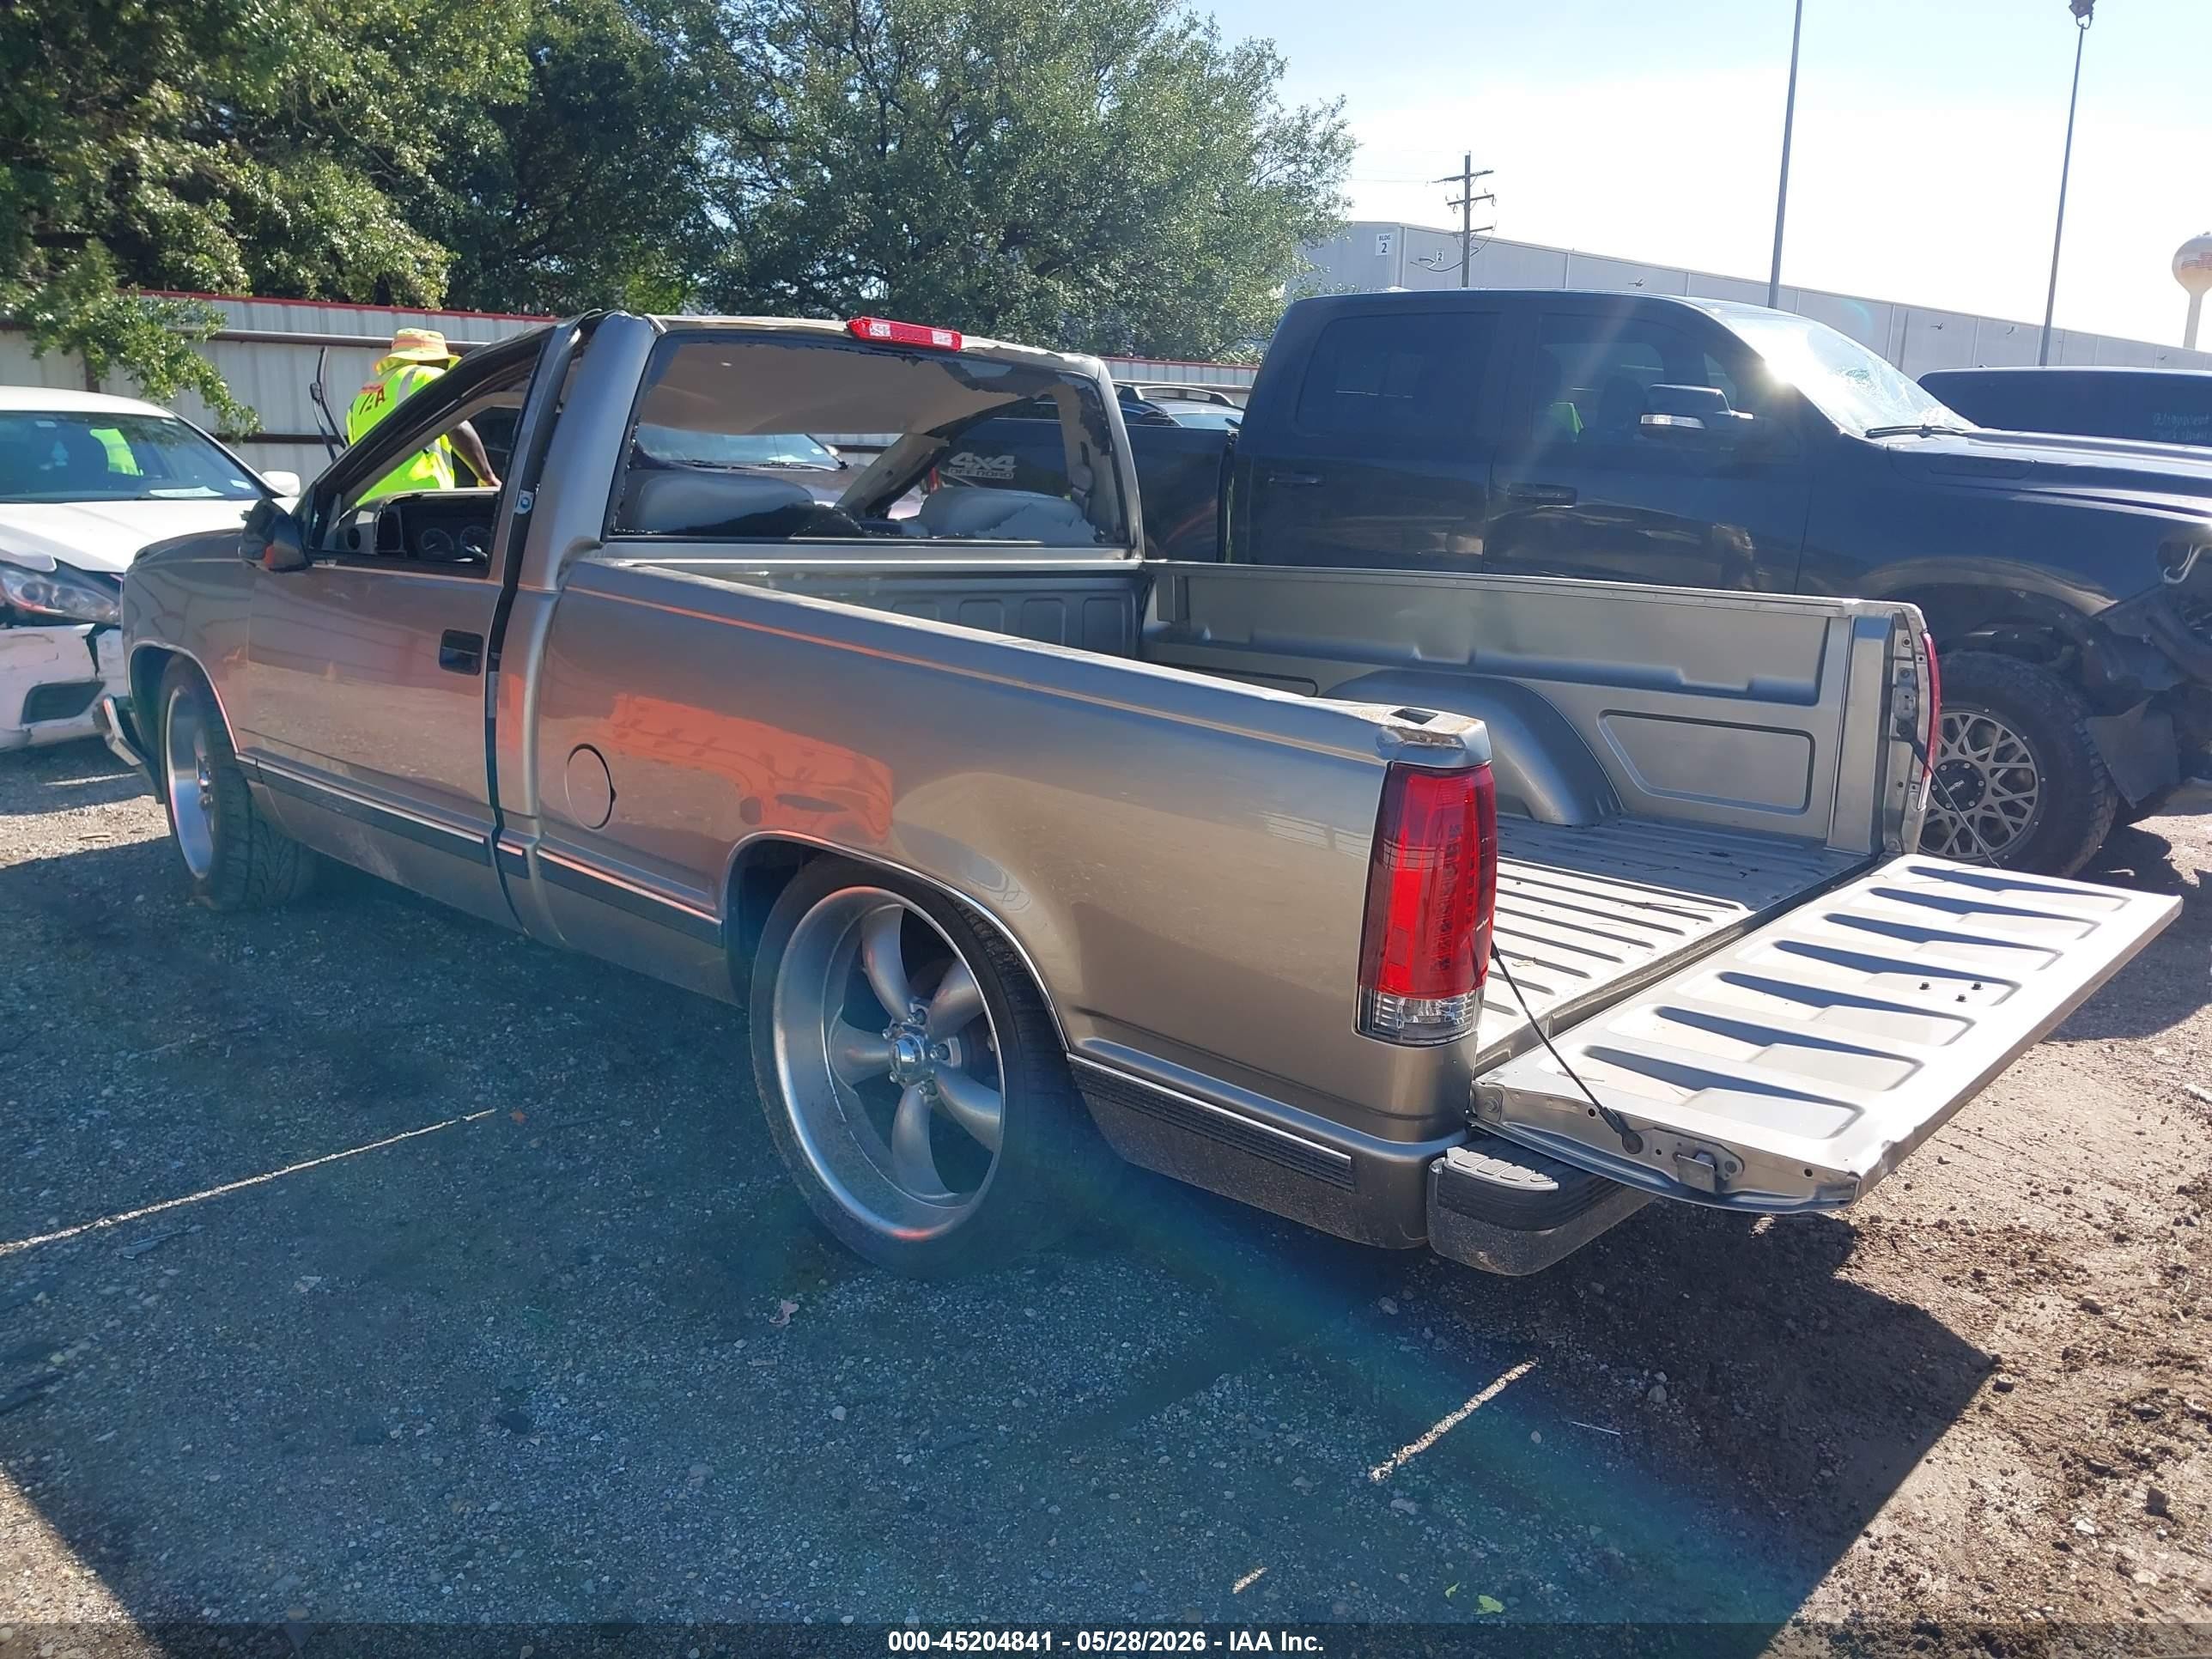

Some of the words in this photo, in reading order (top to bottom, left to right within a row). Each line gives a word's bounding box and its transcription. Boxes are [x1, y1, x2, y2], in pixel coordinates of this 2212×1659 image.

[1381, 242, 1388, 253] 2
[1437, 252, 1443, 261] 2
[950, 468, 971, 477] OFF
[976, 470, 1014, 478] ROAD
